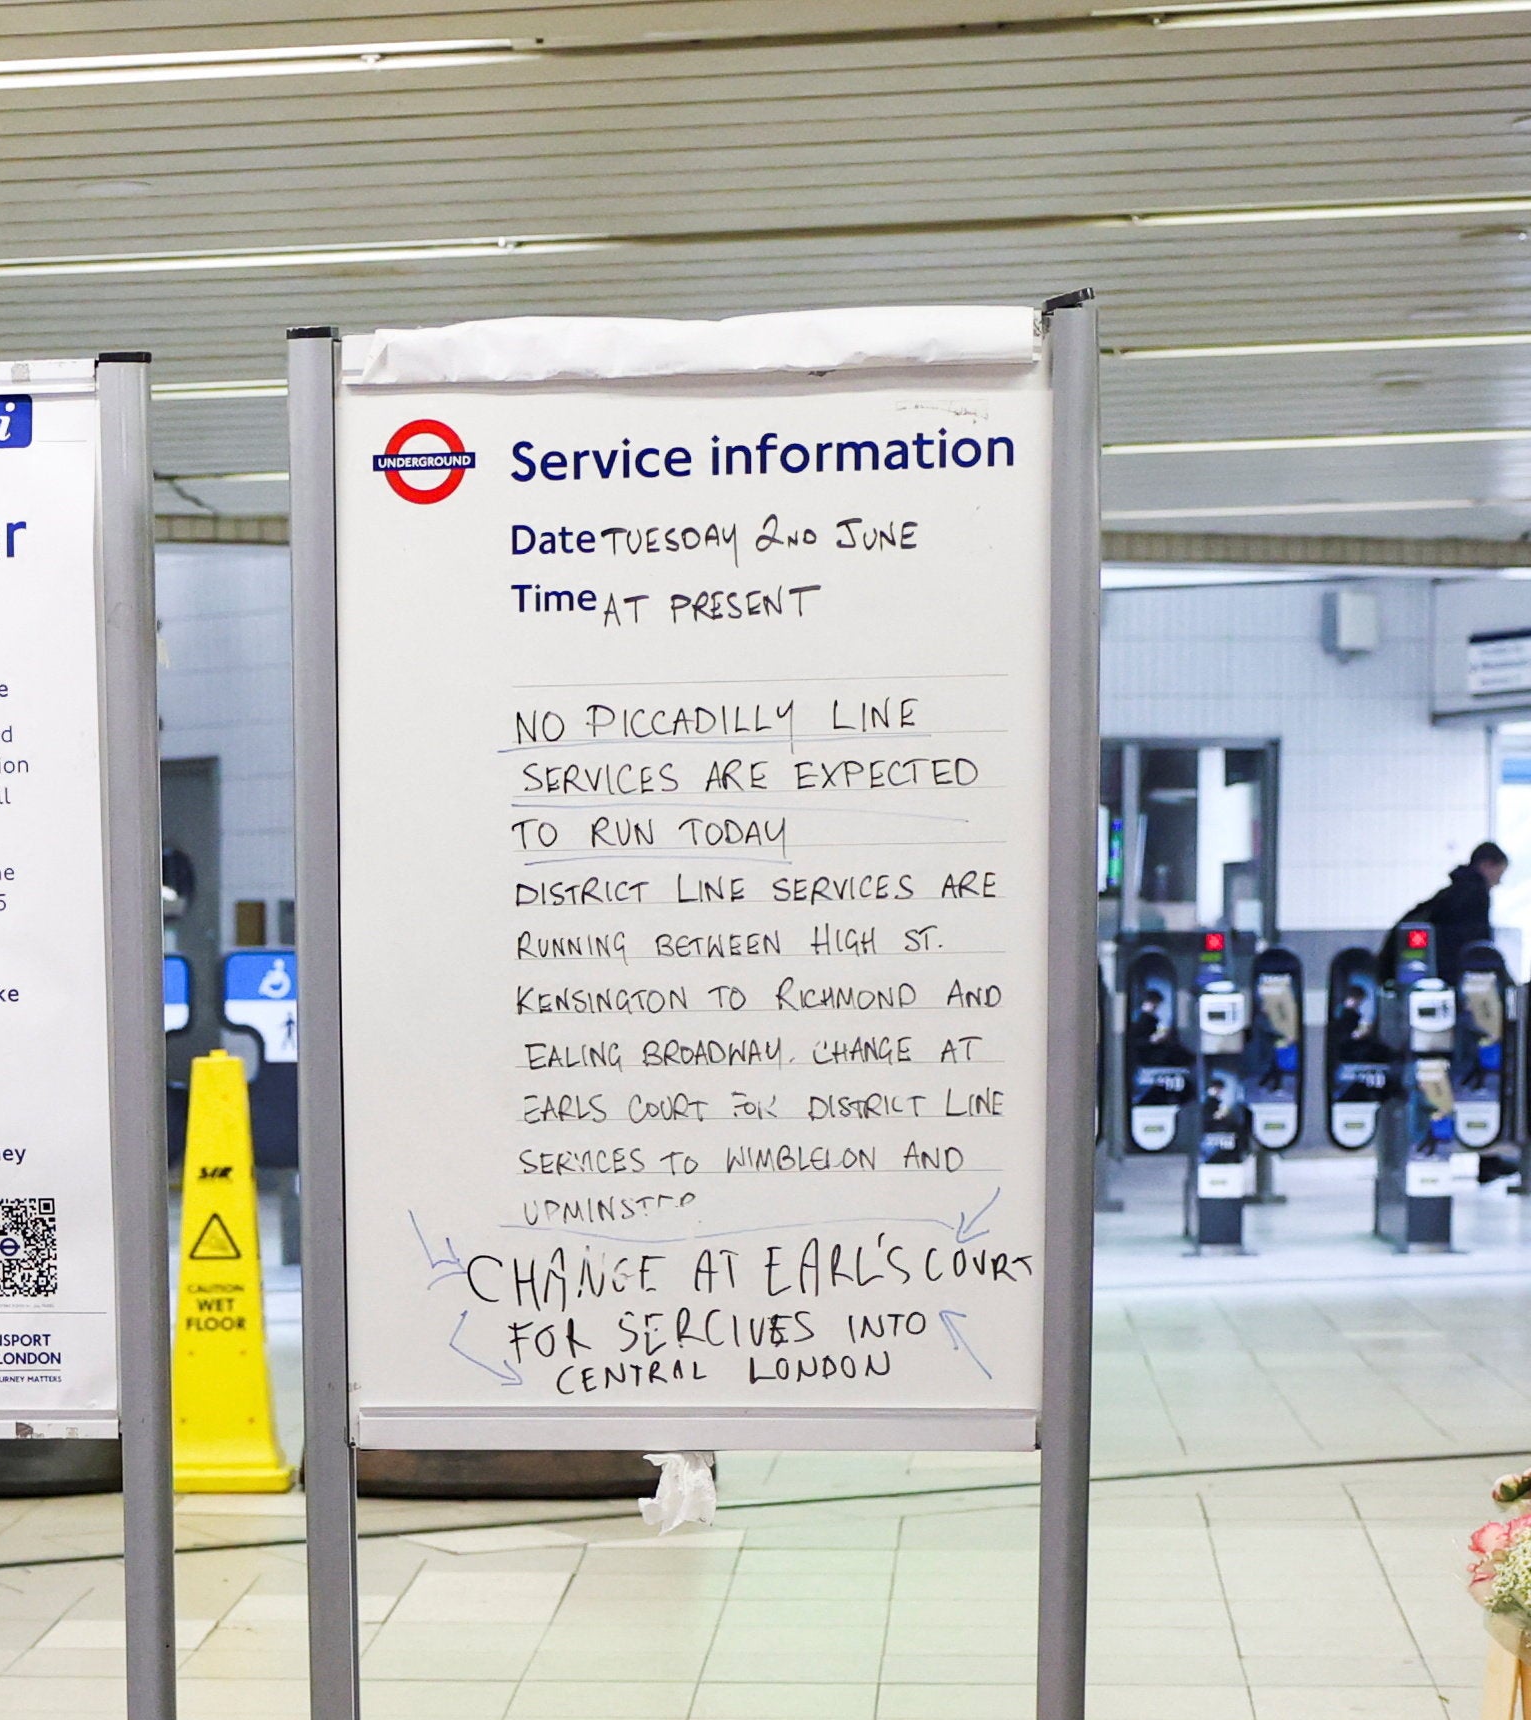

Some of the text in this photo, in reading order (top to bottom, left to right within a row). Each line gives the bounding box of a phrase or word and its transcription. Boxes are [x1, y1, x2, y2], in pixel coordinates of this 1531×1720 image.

[378, 456, 471, 468] UNDERGROUND
[511, 426, 1015, 482] Service information
[511, 524, 595, 556] Date
[601, 522, 740, 568] TUESDAY
[837, 519, 919, 550] JUNE
[511, 584, 821, 628] Time AT PRESENT
[515, 698, 920, 754] NO PICCADILLY LINE
[523, 756, 979, 796] SERVICES ARE EXPECTED
[511, 815, 788, 861] TO RUN TODAY
[515, 871, 998, 908] DISTRICT LINE SERVICES ARE
[517, 925, 945, 966] RUNNING BETWEEN HIGH ST.
[515, 978, 1004, 1016] KENSINGTON TO RICHMOND AND
[525, 1044, 624, 1071] EALING
[813, 1039, 913, 1066] CHANGE
[940, 1036, 983, 1064] AT
[523, 1094, 609, 1125] EARLS
[629, 1095, 710, 1123] COURT
[809, 1092, 929, 1122] DISTRICT
[946, 1090, 1005, 1118] LINE
[660, 1152, 699, 1176] TO
[903, 1144, 965, 1173] AND
[468, 1232, 1034, 1311] CHANGE AT EARL'S COURT
[185, 1317, 247, 1332] FLOOR
[197, 1298, 235, 1313] WET
[509, 1310, 928, 1362] FOR SERCIVES INTO
[26, 1374, 62, 1383] MATTERS
[557, 1352, 891, 1396] CENTRAL LONDON
